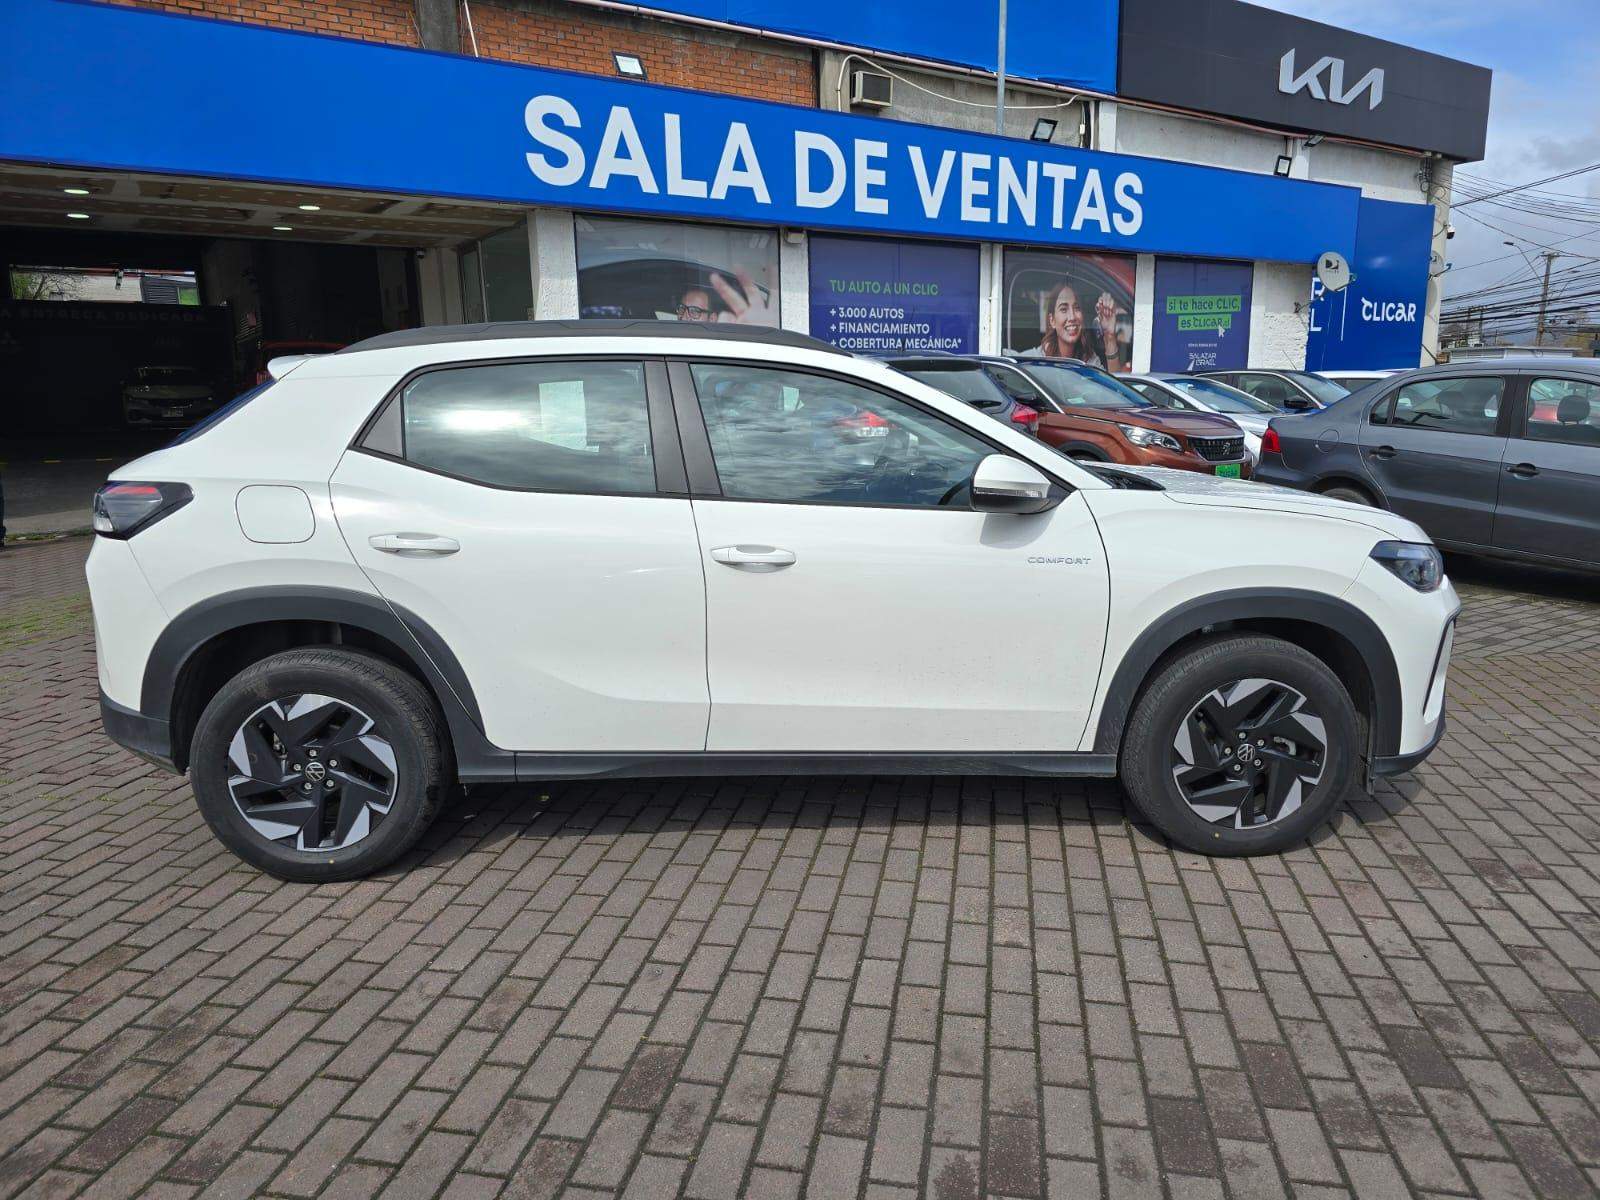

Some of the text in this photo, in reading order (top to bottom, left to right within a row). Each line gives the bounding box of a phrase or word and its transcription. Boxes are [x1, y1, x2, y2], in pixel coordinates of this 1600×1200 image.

[524, 95, 1144, 236] SALA DE VENTAS
[830, 279, 938, 296] TU AUTO A UN CLIC
[1179, 299, 1188, 310] te
[1192, 298, 1213, 310] hace
[839, 307, 867, 318] 3.000
[869, 307, 904, 319] AUTOS
[839, 322, 930, 334] FINANCIAMIENTO
[1181, 319, 1191, 328] es
[839, 337, 903, 349] COBERTURA
[1028, 556, 1092, 565] COMFORT
